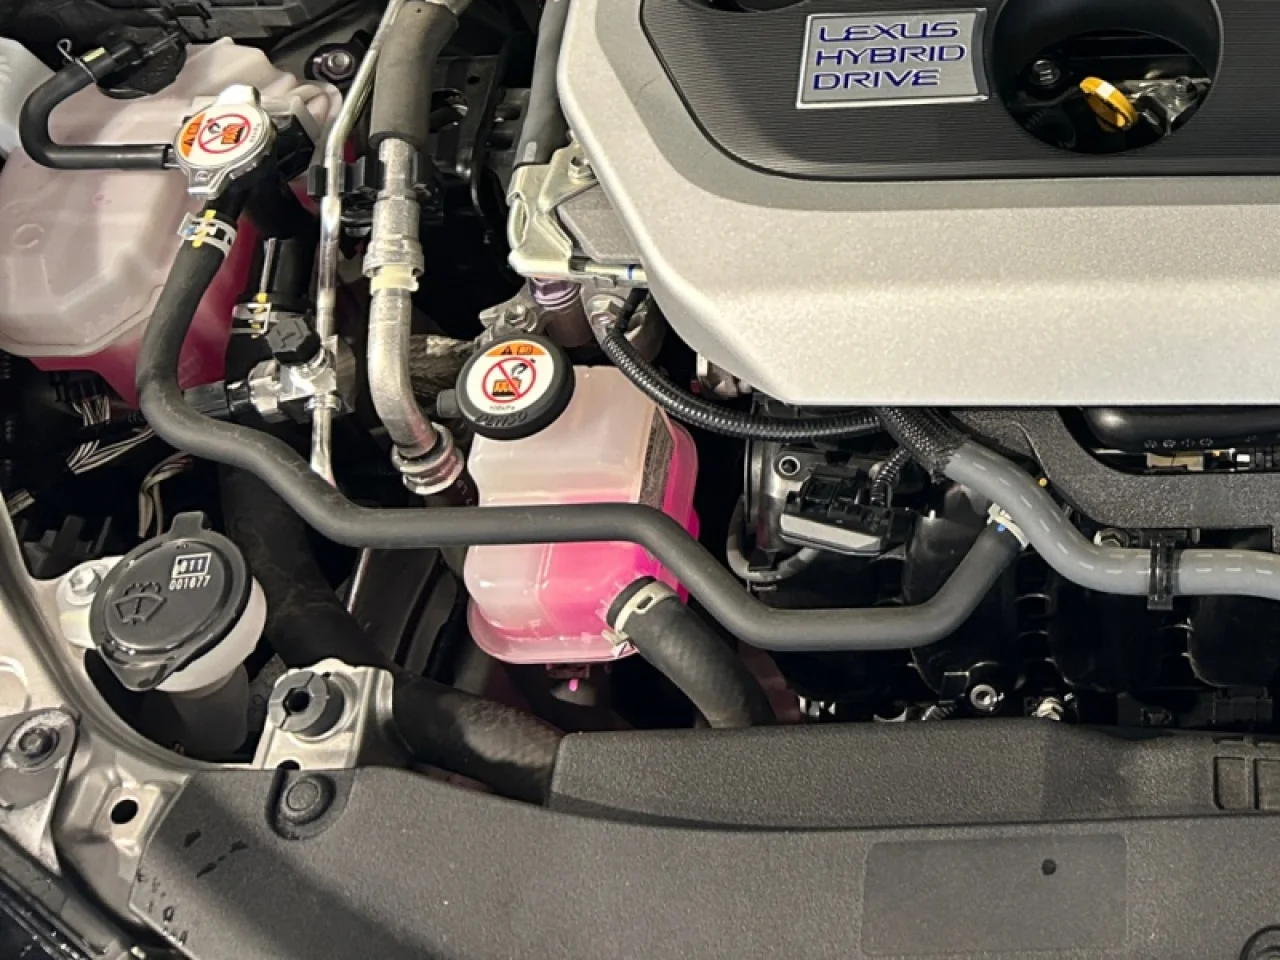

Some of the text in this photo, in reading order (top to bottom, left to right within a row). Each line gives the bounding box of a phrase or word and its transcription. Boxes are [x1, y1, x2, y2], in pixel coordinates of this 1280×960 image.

[818, 21, 961, 43] LEXUS
[815, 44, 967, 67] HYBRID
[812, 68, 942, 91] DRIVE
